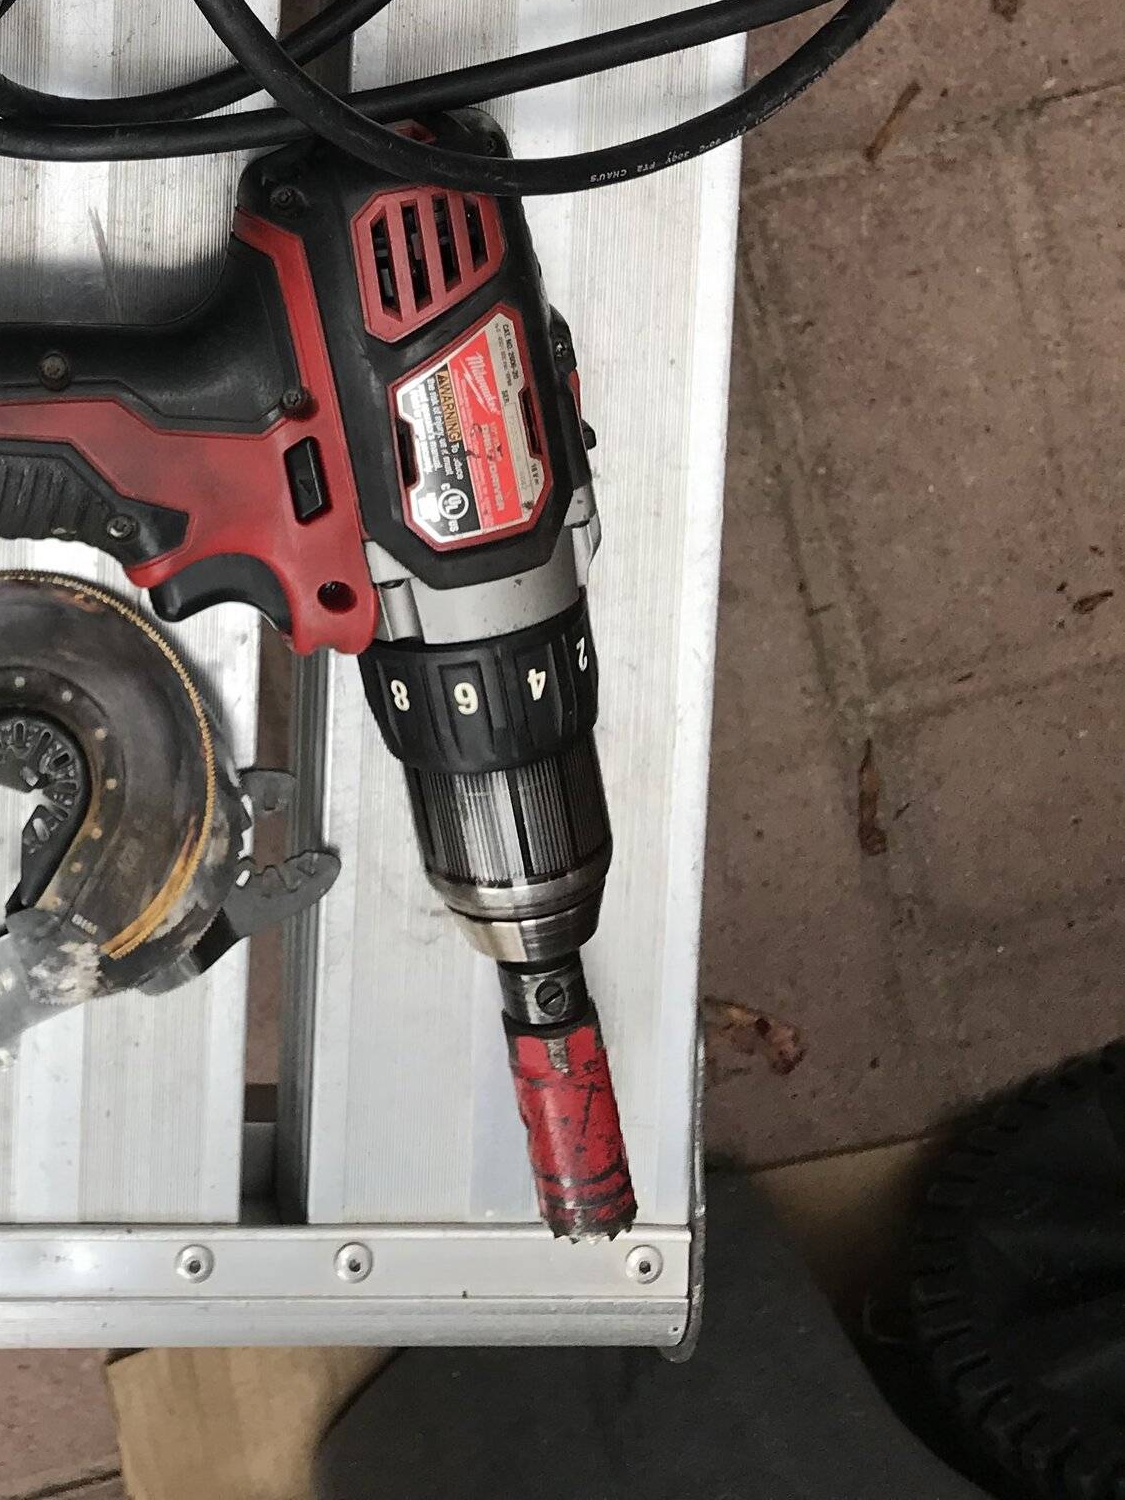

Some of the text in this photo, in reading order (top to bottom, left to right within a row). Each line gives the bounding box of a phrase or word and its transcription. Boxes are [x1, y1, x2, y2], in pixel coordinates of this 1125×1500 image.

[439, 383, 461, 442] WARNING
[390, 679, 410, 712] 8
[527, 668, 546, 701] 4
